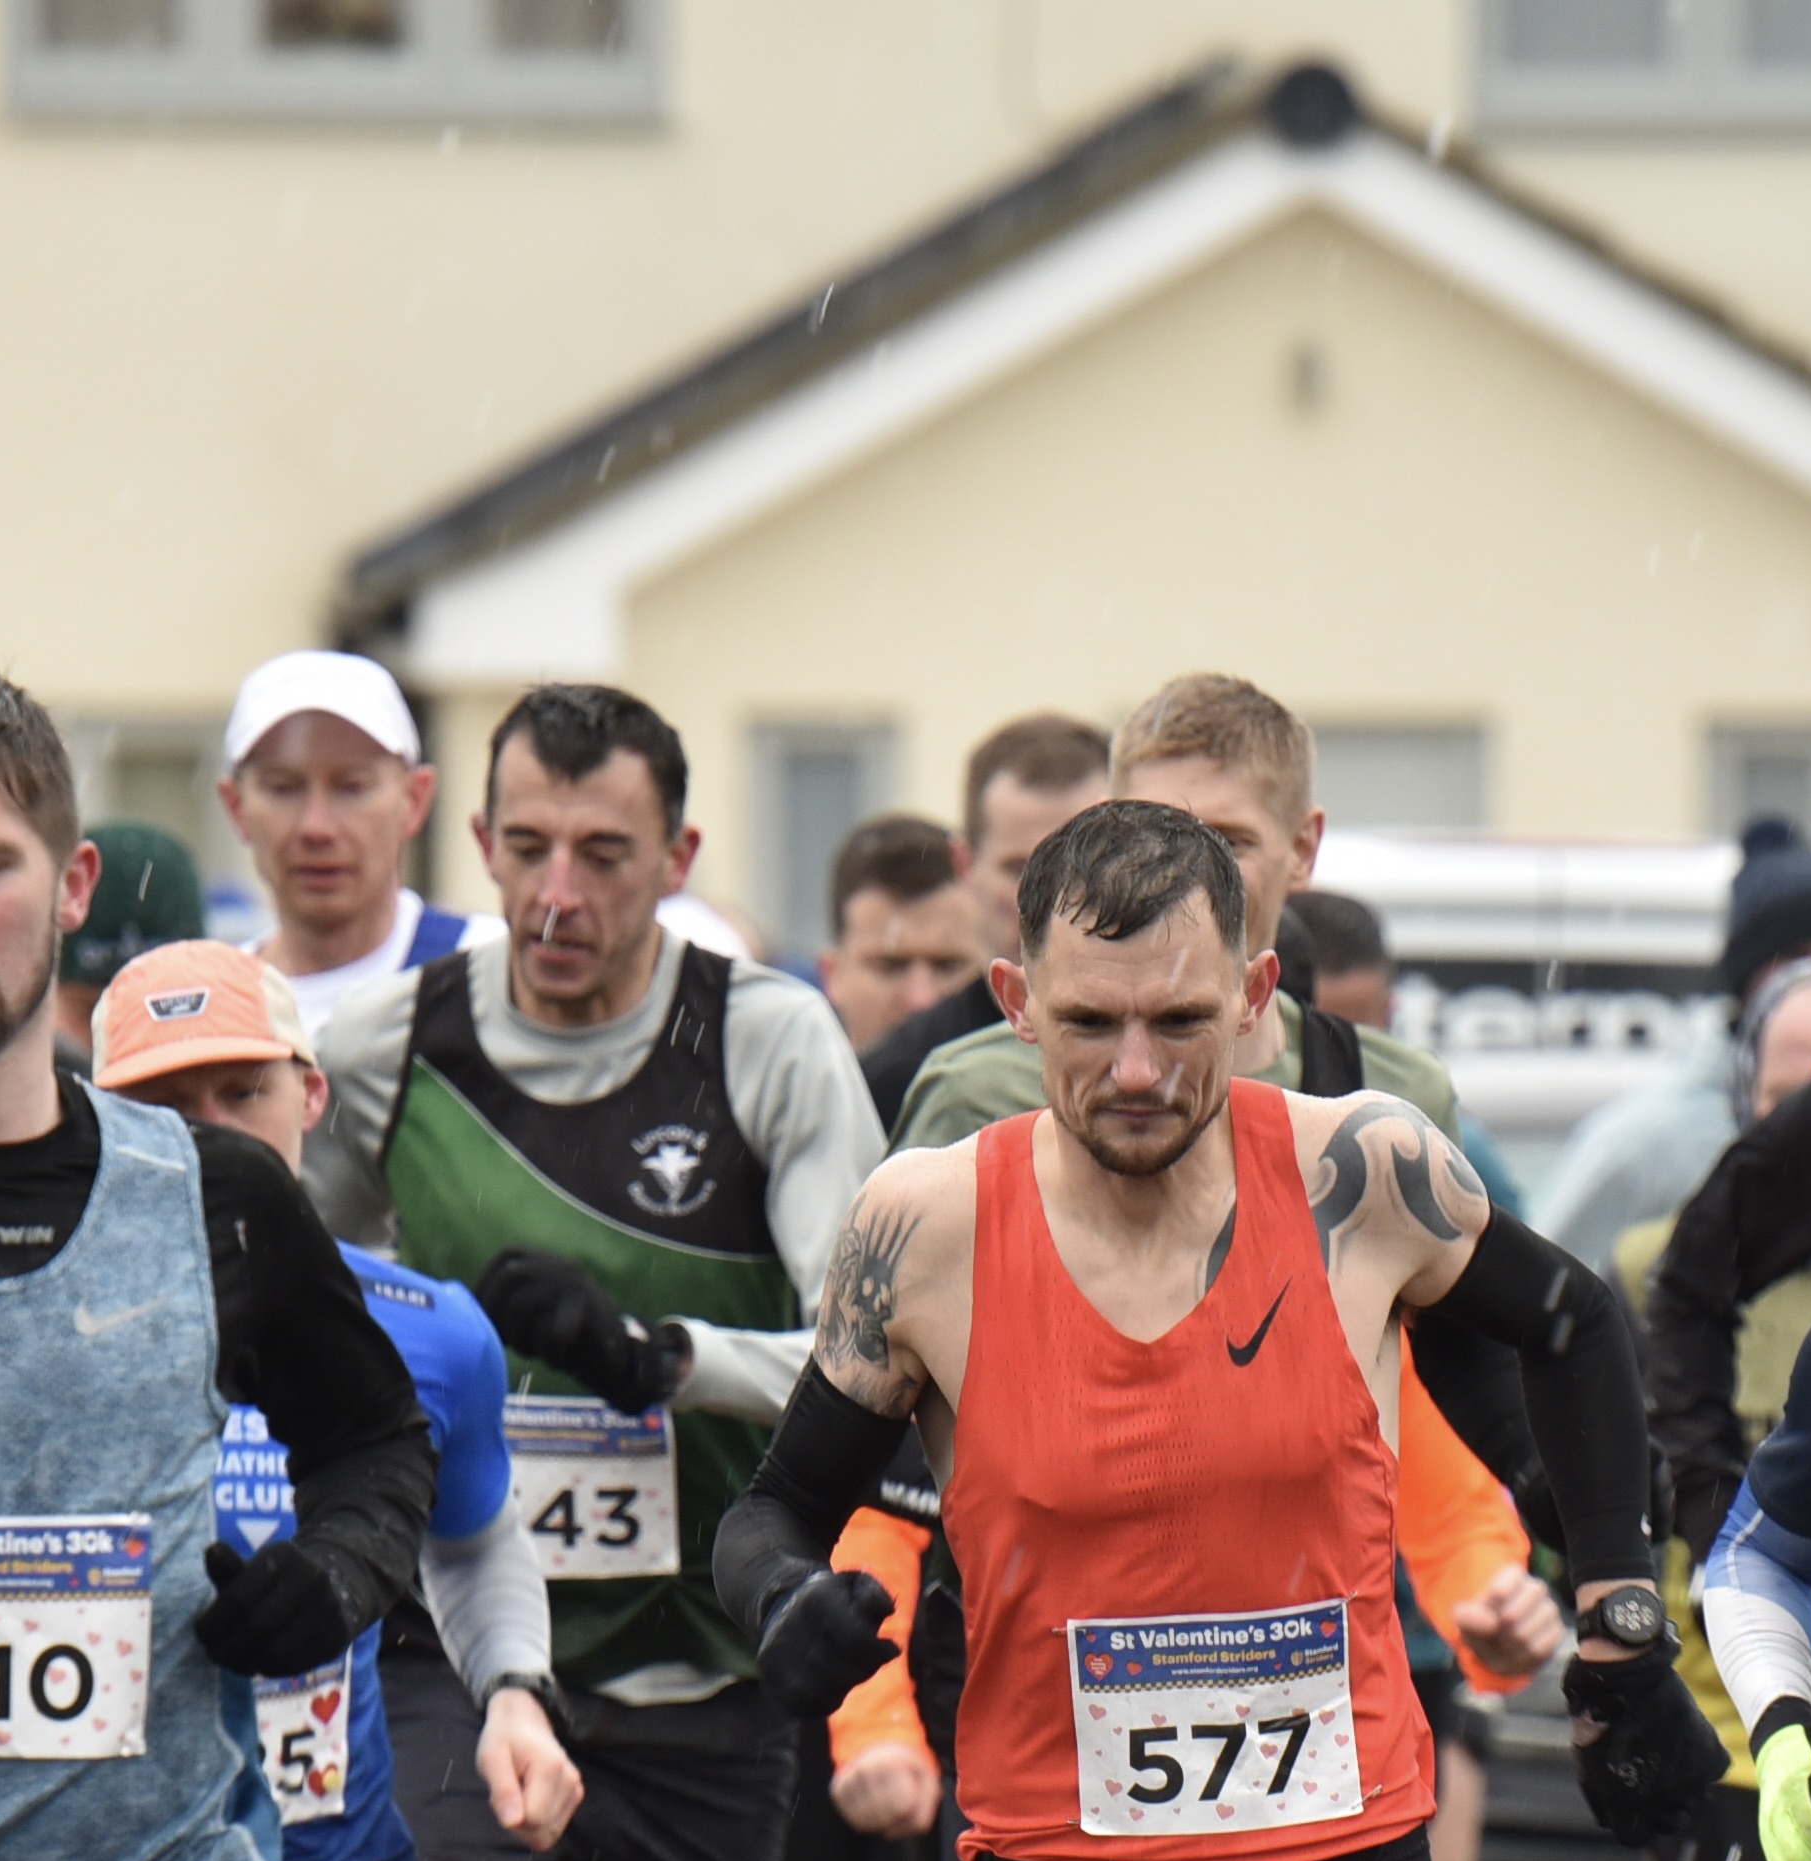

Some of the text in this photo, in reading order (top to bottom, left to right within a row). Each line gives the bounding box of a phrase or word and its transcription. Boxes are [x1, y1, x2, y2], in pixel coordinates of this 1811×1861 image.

[514, 1486, 641, 1547] 43
[66, 1529, 114, 1554] 30k
[1110, 1617, 1313, 1651] St Valentine's 30k
[1152, 1648, 1277, 1667] Stamford Striders
[1126, 1712, 1311, 1805] 577
